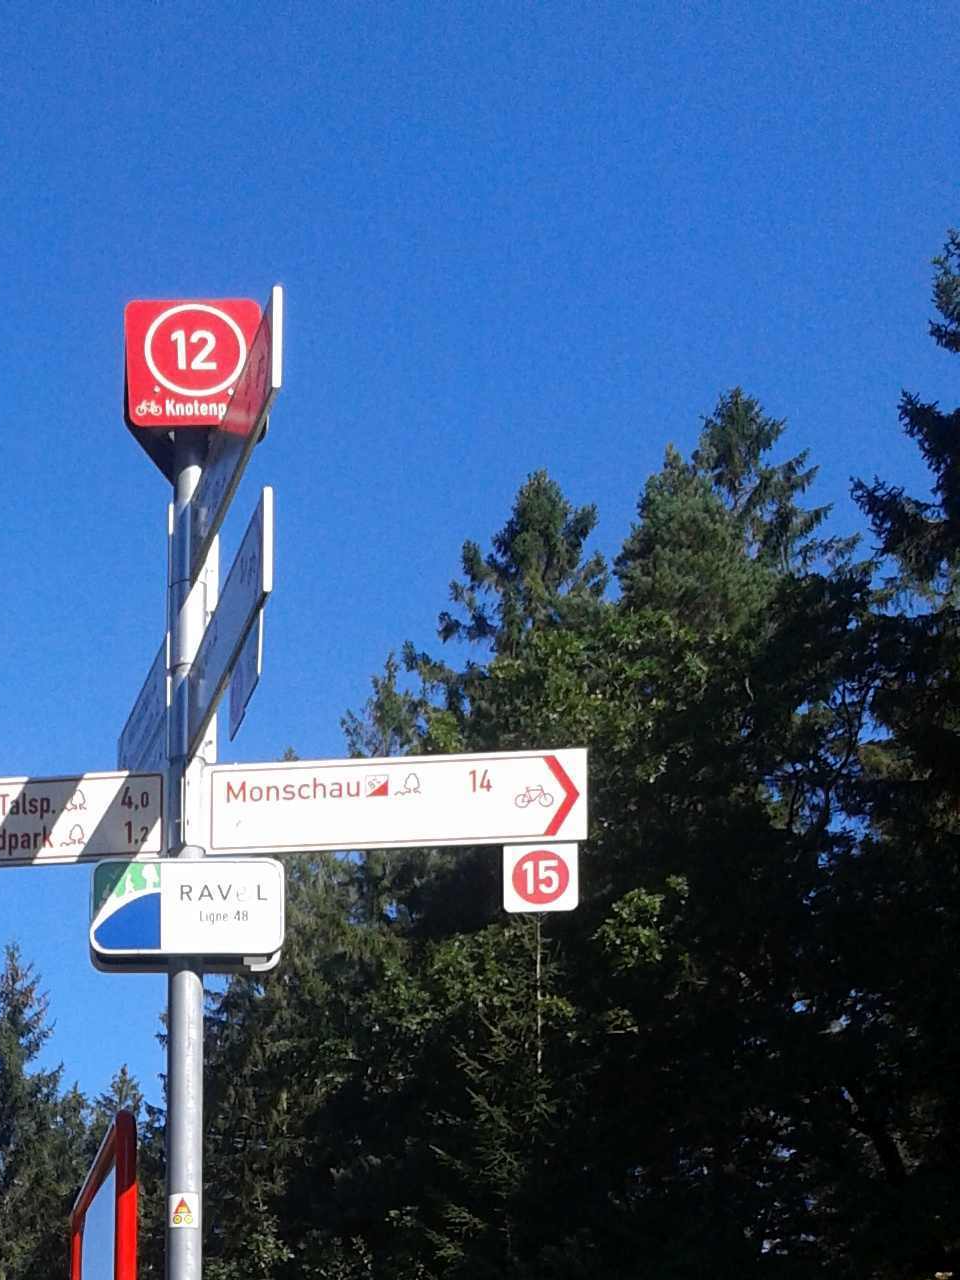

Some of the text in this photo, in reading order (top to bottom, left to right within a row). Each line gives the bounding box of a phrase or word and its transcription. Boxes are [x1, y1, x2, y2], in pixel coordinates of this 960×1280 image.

[170, 330, 218, 370] 12
[165, 399, 227, 420] Knotenp
[225, 769, 493, 803] Monschau 14
[0, 794, 56, 822] Talsp.
[121, 787, 150, 810] 4,0
[124, 821, 149, 845] 1,2
[521, 859, 560, 895] 15
[199, 910, 249, 925] Ligne 48
